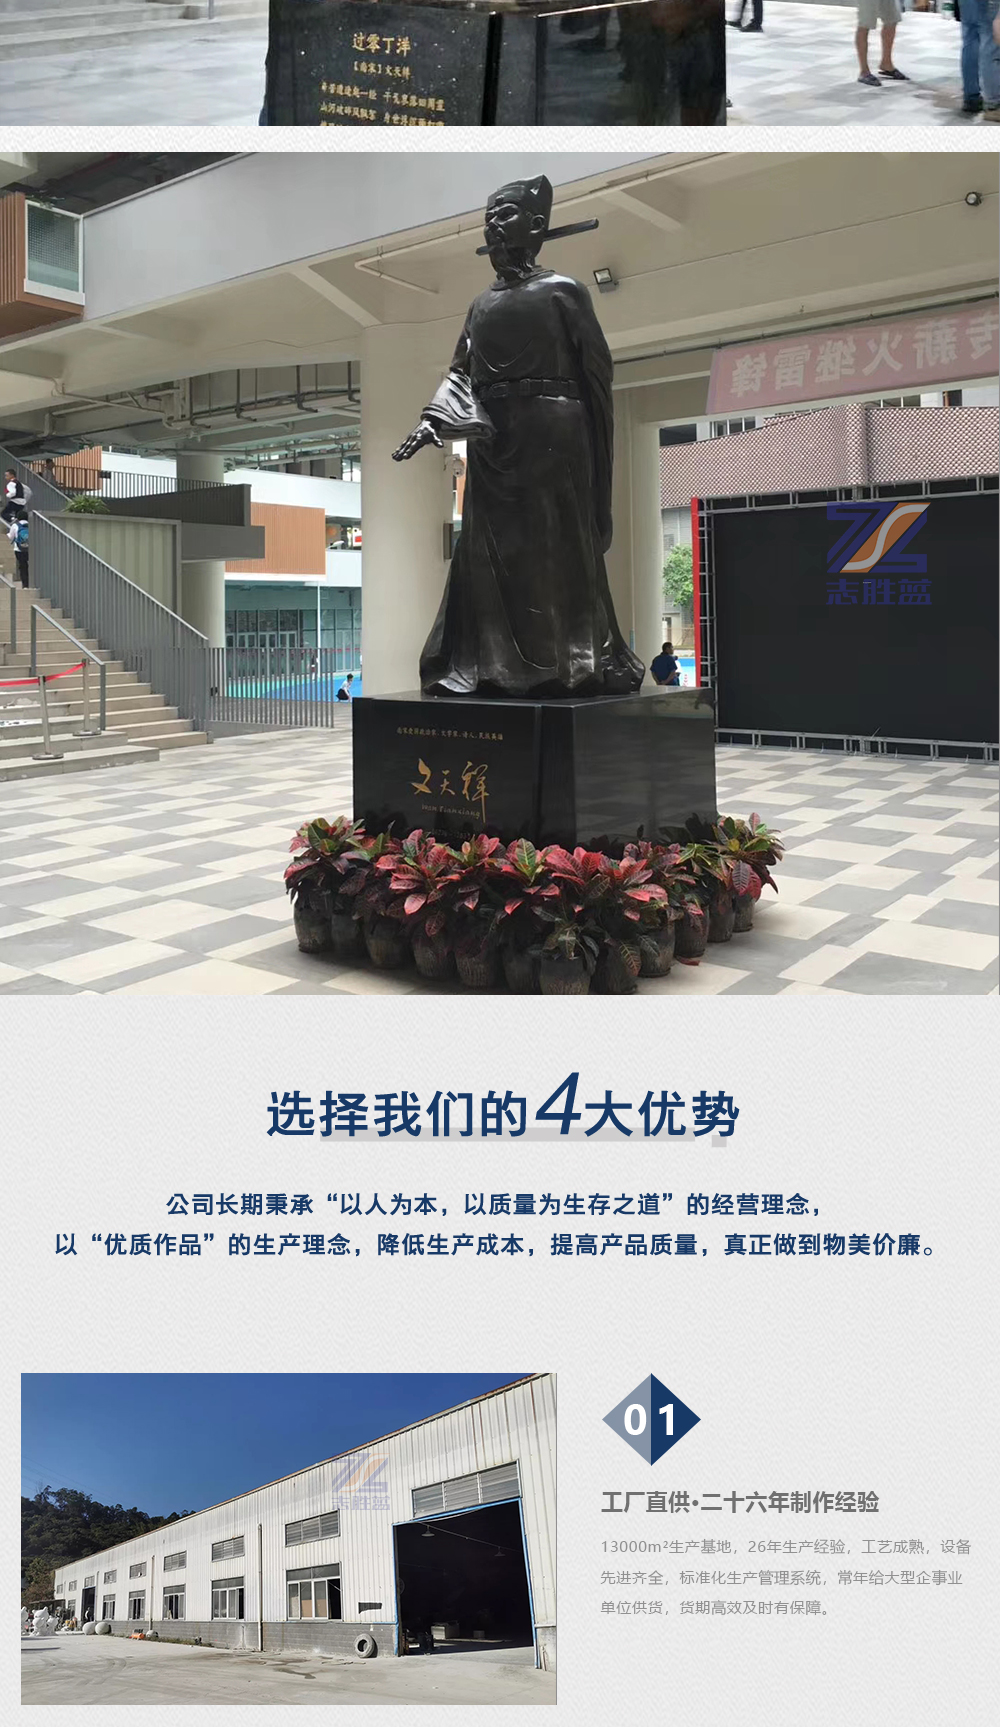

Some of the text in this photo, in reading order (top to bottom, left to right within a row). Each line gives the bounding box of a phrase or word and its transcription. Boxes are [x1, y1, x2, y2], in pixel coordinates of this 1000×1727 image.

[352, 31, 411, 57] 过零丁洋
[411, 758, 490, 823] 文天祥
